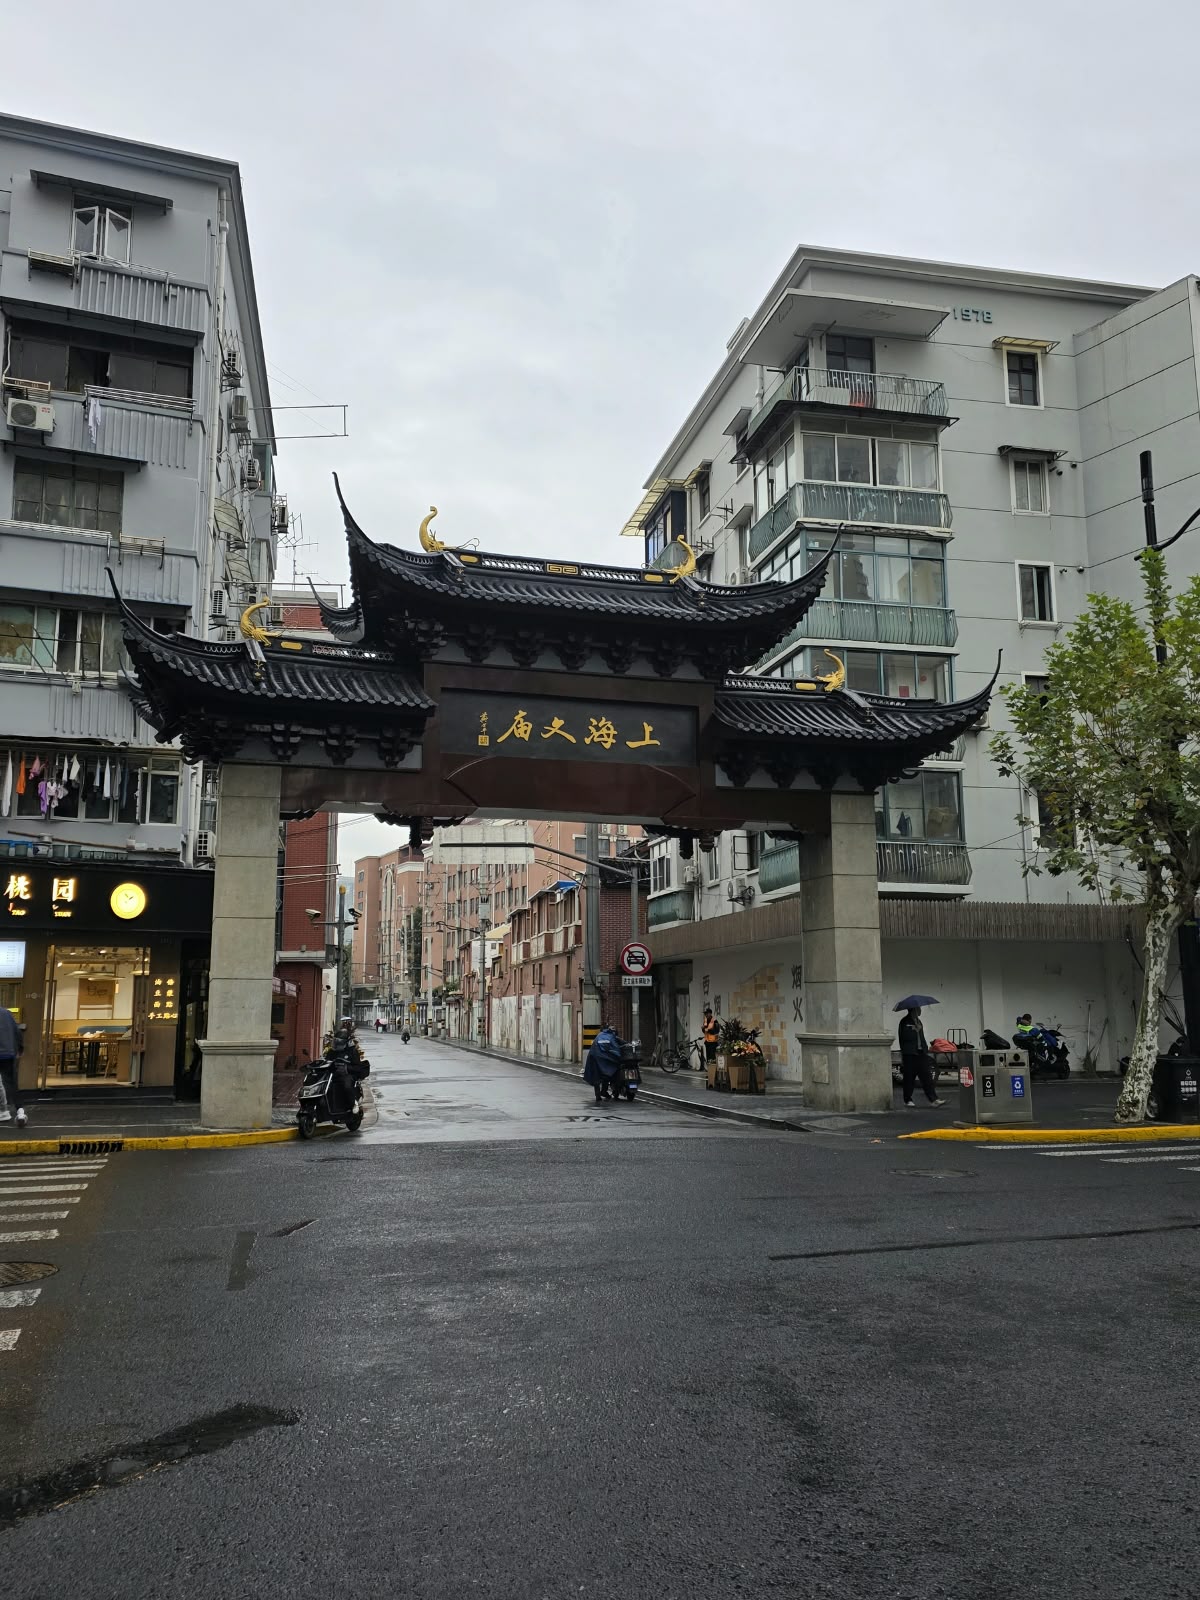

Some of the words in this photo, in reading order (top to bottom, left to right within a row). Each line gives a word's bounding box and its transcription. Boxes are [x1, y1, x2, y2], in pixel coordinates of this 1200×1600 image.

[953, 307, 993, 324] 1978
[497, 709, 661, 750] 上海文庙
